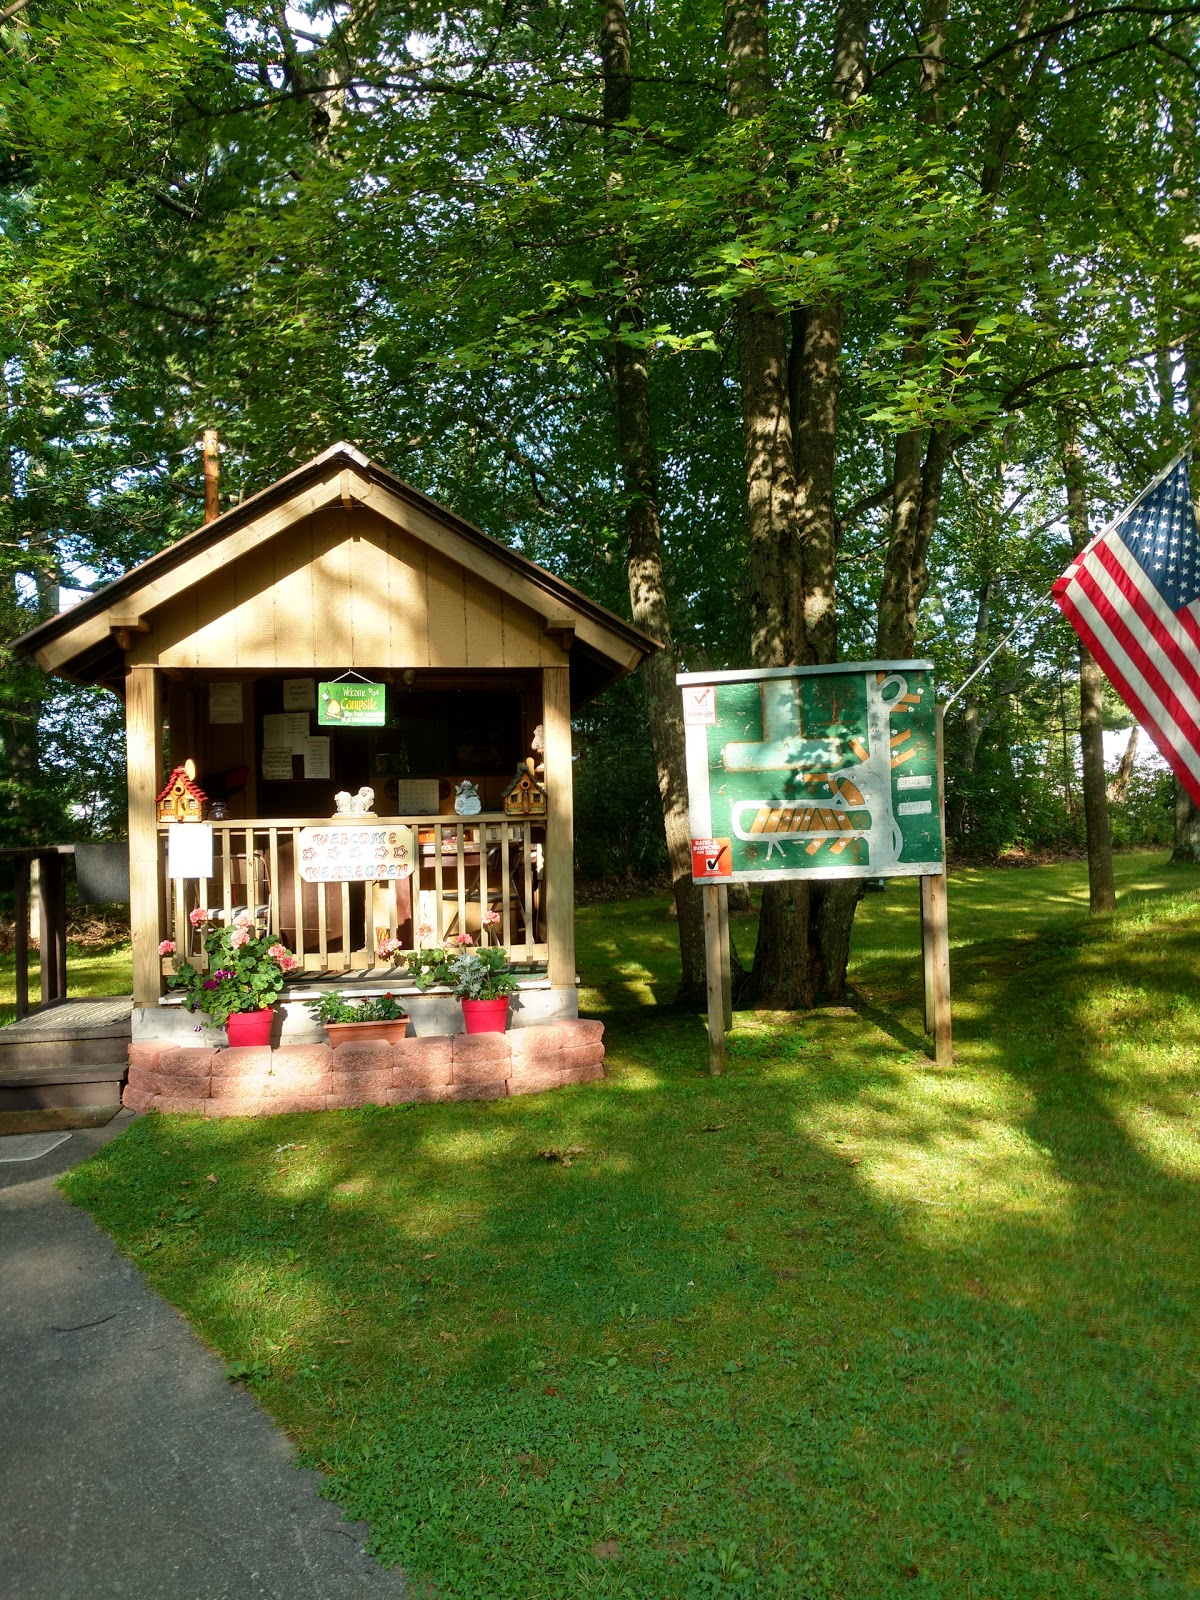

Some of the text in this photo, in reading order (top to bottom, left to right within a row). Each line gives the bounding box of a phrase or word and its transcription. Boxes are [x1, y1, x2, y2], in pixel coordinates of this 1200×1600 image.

[343, 687, 366, 696] Welcome
[340, 698, 377, 711] Campsite
[312, 831, 397, 846] WELCOME
[305, 863, 409, 880] WE ARE OPEN
